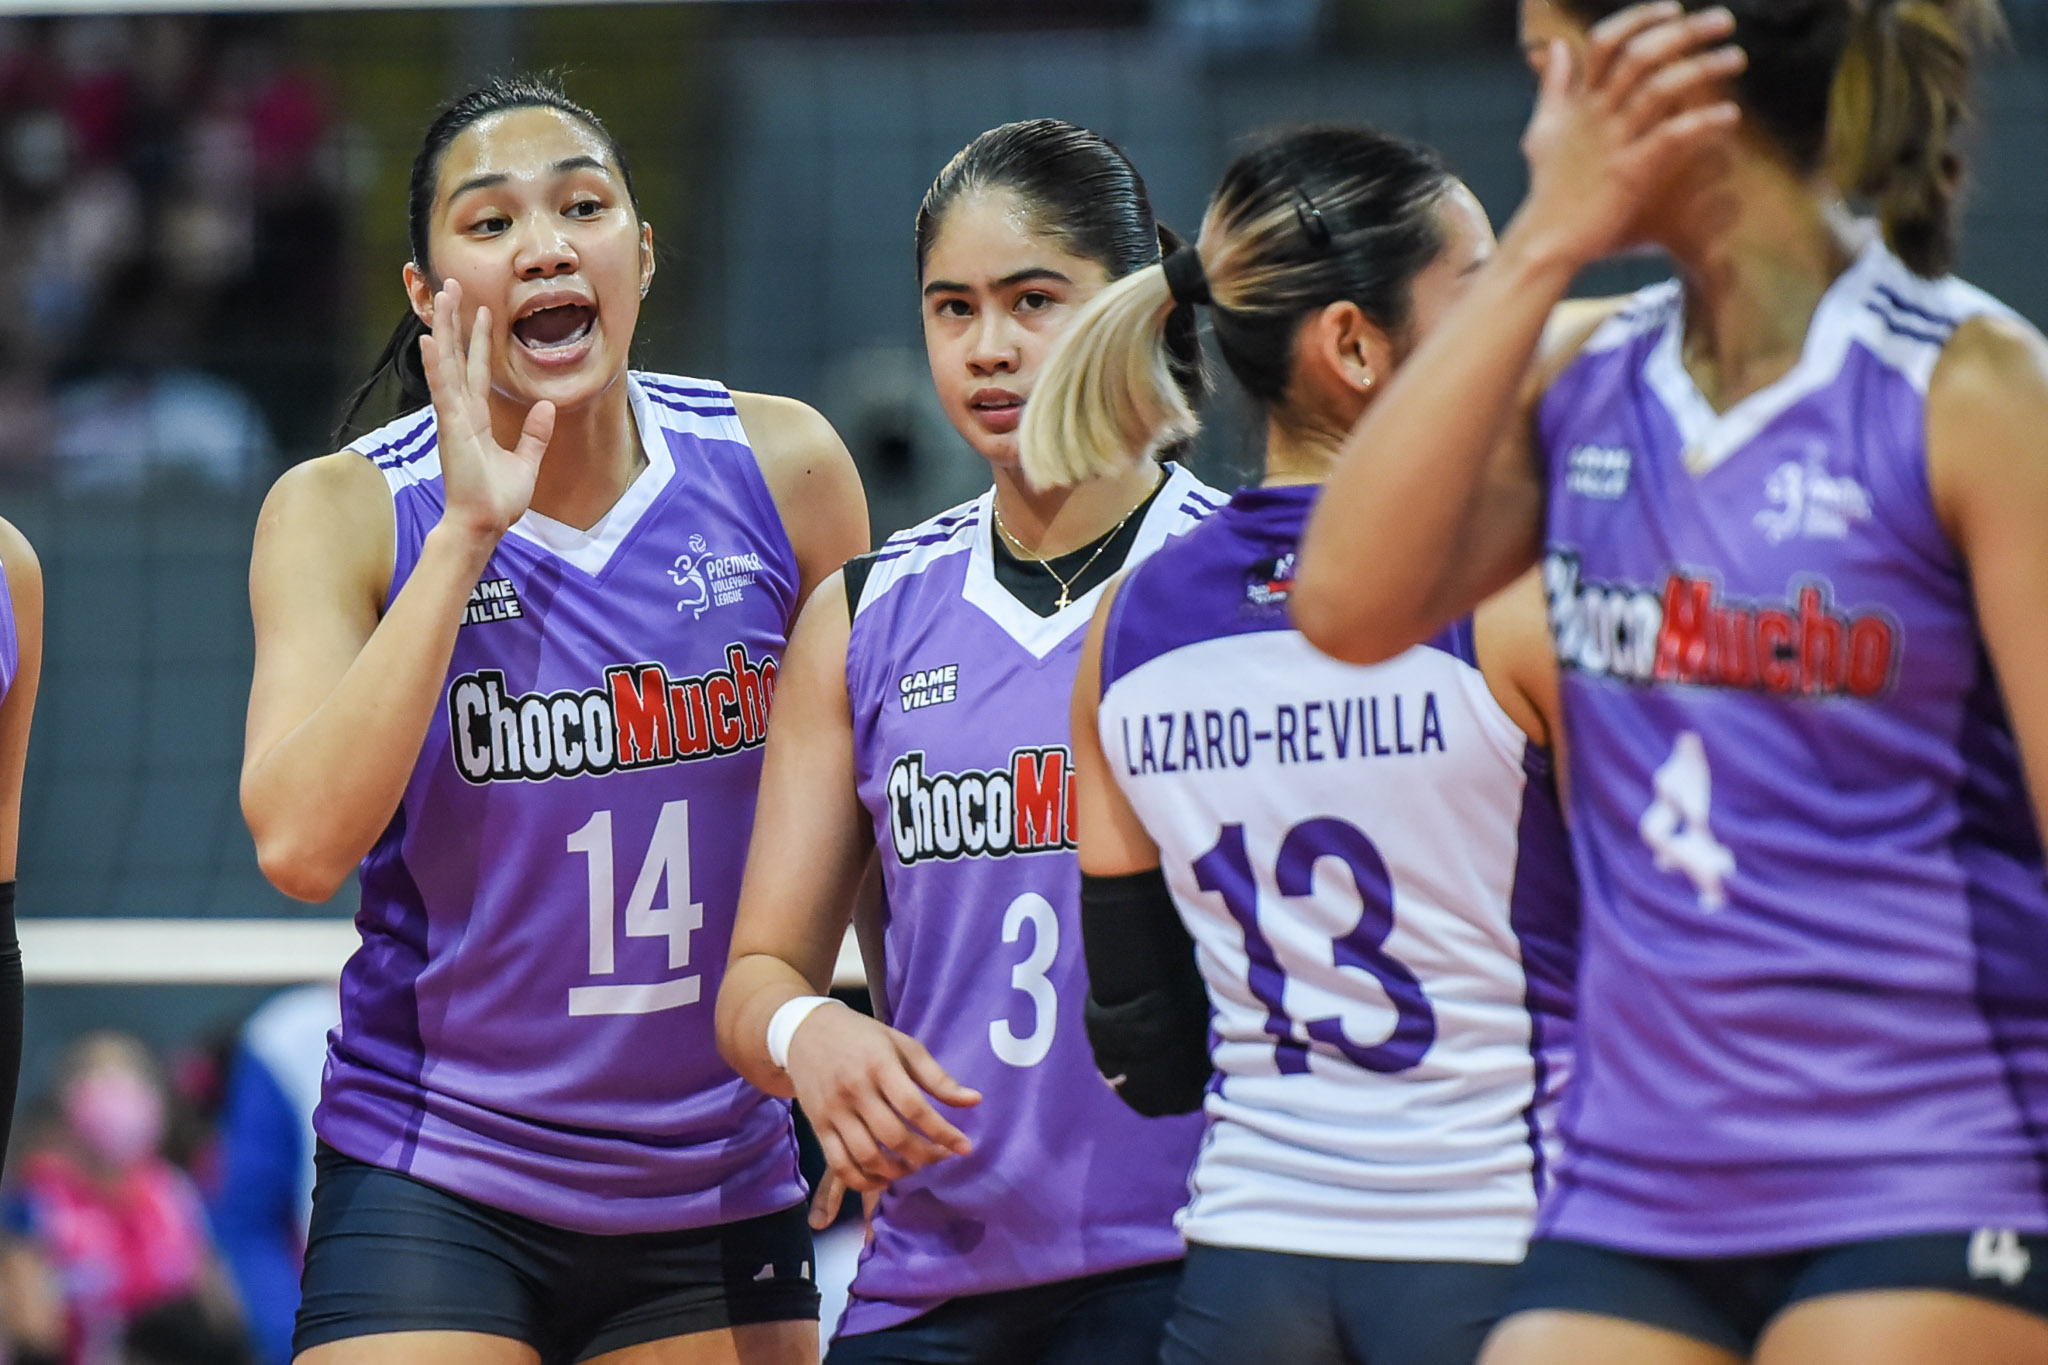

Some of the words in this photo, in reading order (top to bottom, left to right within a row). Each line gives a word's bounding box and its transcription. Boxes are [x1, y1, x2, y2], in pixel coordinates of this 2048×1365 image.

[706, 552, 763, 580] PREMIER
[711, 573, 756, 594] VOLLEYBALL
[468, 579, 515, 600] AME
[714, 589, 744, 607] LEAGUE
[900, 665, 958, 693] GAME
[901, 685, 956, 711] VILLE
[1123, 691, 1446, 776] LAZARO-REVILLA
[1640, 732, 1735, 913] 4
[567, 799, 703, 975] 14
[1192, 816, 1437, 1075] 13
[989, 891, 1060, 1067] 3
[1970, 1227, 2031, 1285] 4
